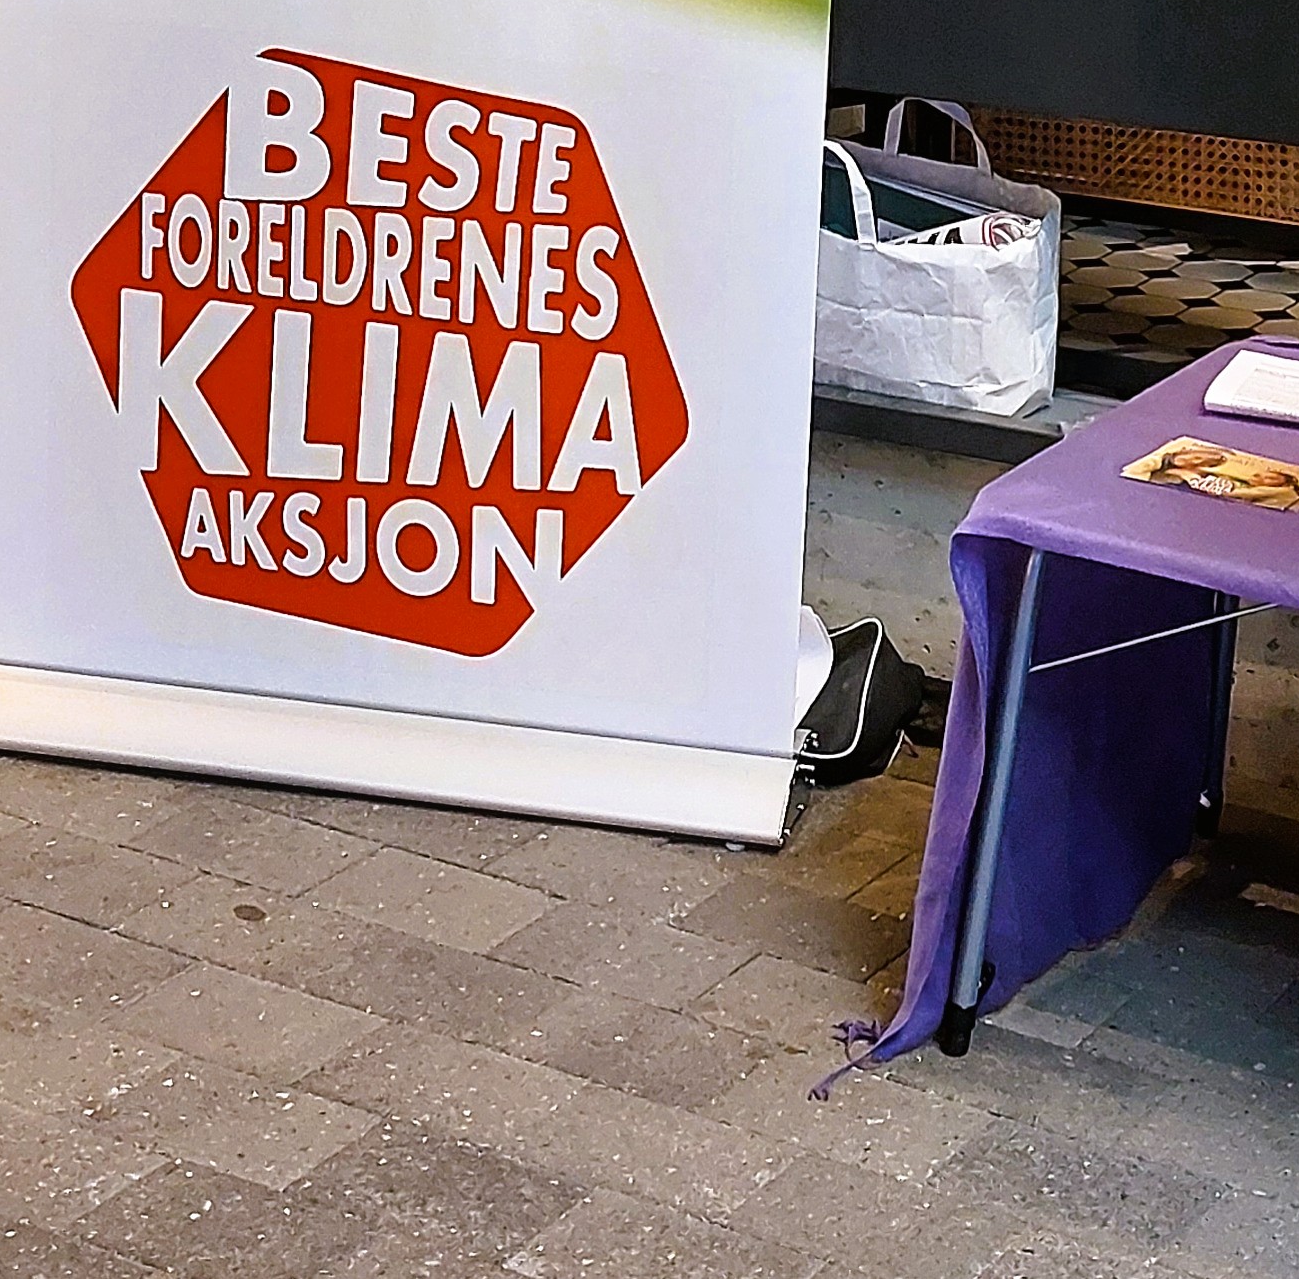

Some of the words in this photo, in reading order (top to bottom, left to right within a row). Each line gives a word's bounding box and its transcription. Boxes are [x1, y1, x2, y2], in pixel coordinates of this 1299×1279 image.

[223, 55, 576, 214] BESTE
[140, 191, 620, 341] FORELDRENES
[117, 287, 643, 496] KLIMA
[180, 487, 563, 606] AKSJON
